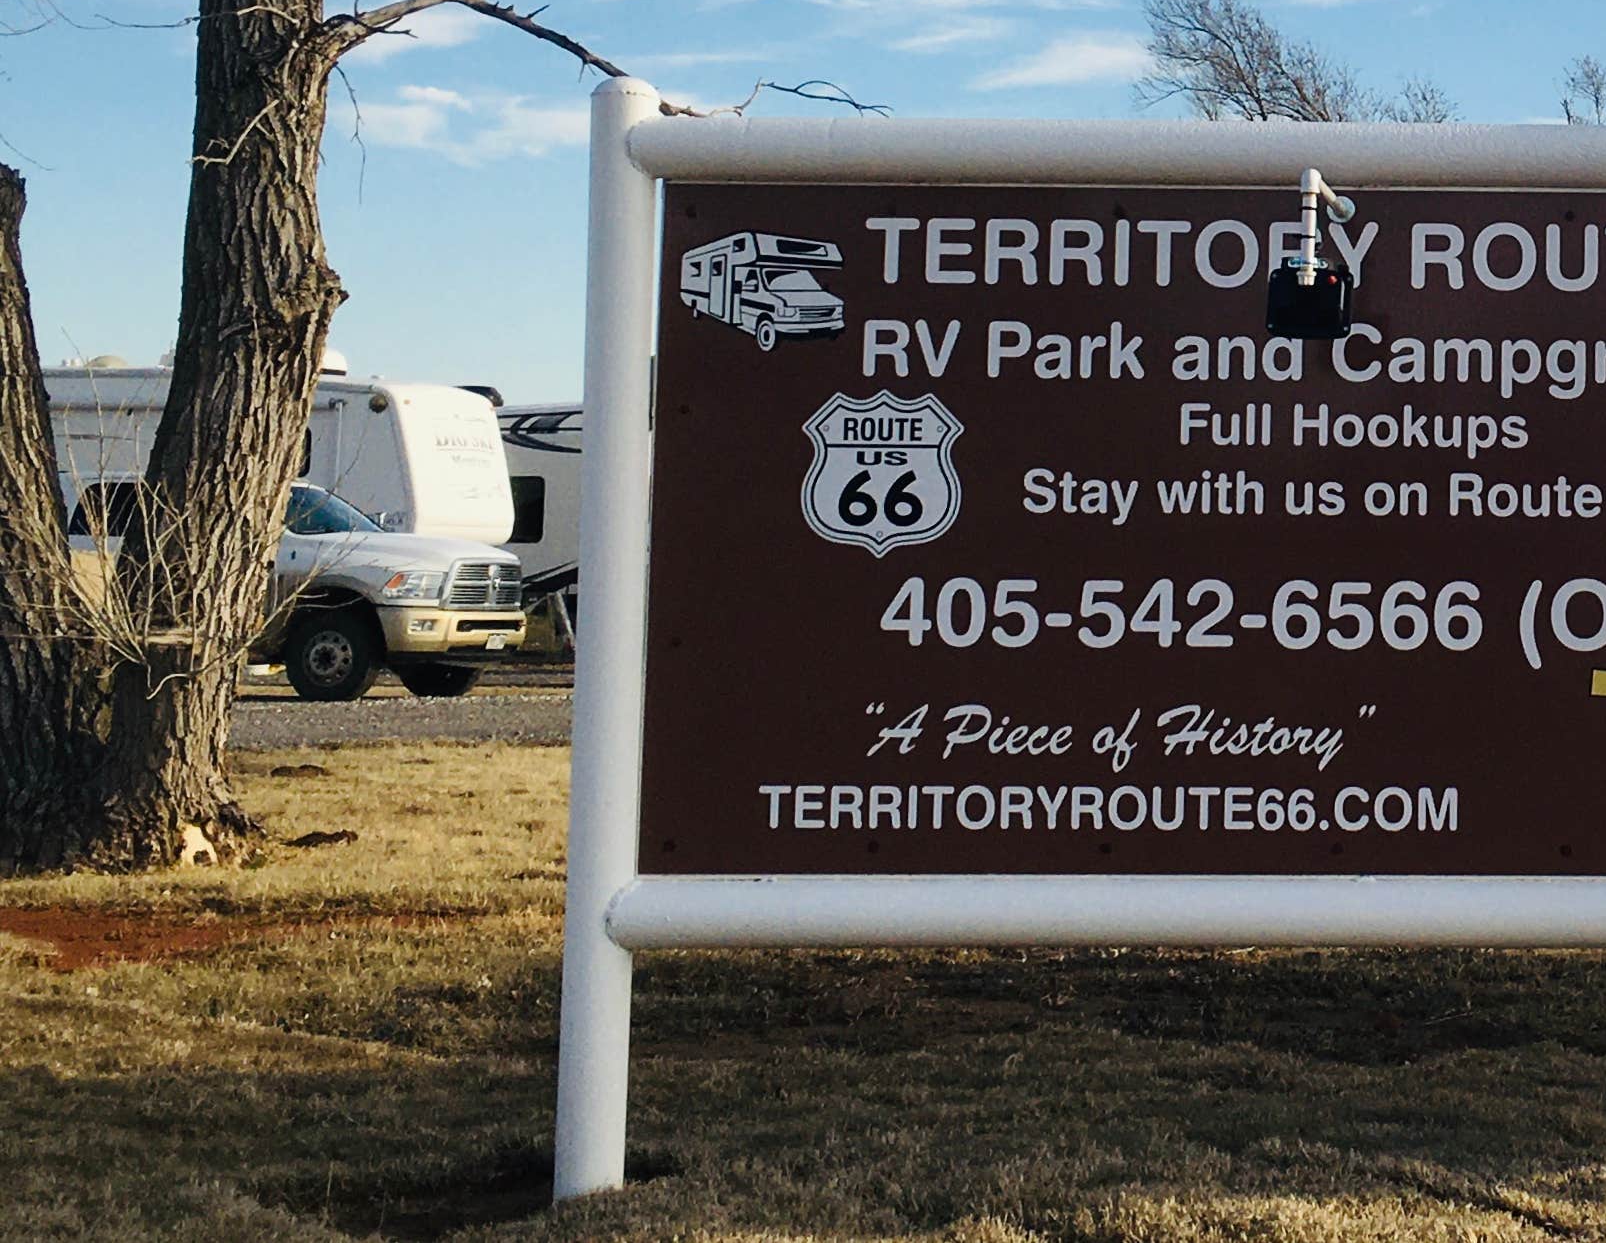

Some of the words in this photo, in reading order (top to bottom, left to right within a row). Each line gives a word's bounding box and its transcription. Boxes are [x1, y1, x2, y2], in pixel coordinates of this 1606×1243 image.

[863, 319, 960, 377] RV
[988, 321, 1144, 379] Park
[1172, 336, 1303, 381] and
[843, 417, 923, 442] ROUTE
[1181, 403, 1271, 445] Full
[1294, 404, 1528, 459] Hookups
[856, 451, 908, 467] US
[838, 470, 924, 527] 66
[1023, 469, 1138, 525] Stay
[1157, 470, 1263, 515] with
[1286, 482, 1345, 515] us
[1365, 483, 1427, 516] on
[1450, 473, 1602, 517] Route
[881, 577, 1482, 650] 405-542-6566
[943, 705, 1072, 759] Piece
[1093, 708, 1140, 772] of
[759, 785, 1459, 831] TERRITORYROUTE66.COM
